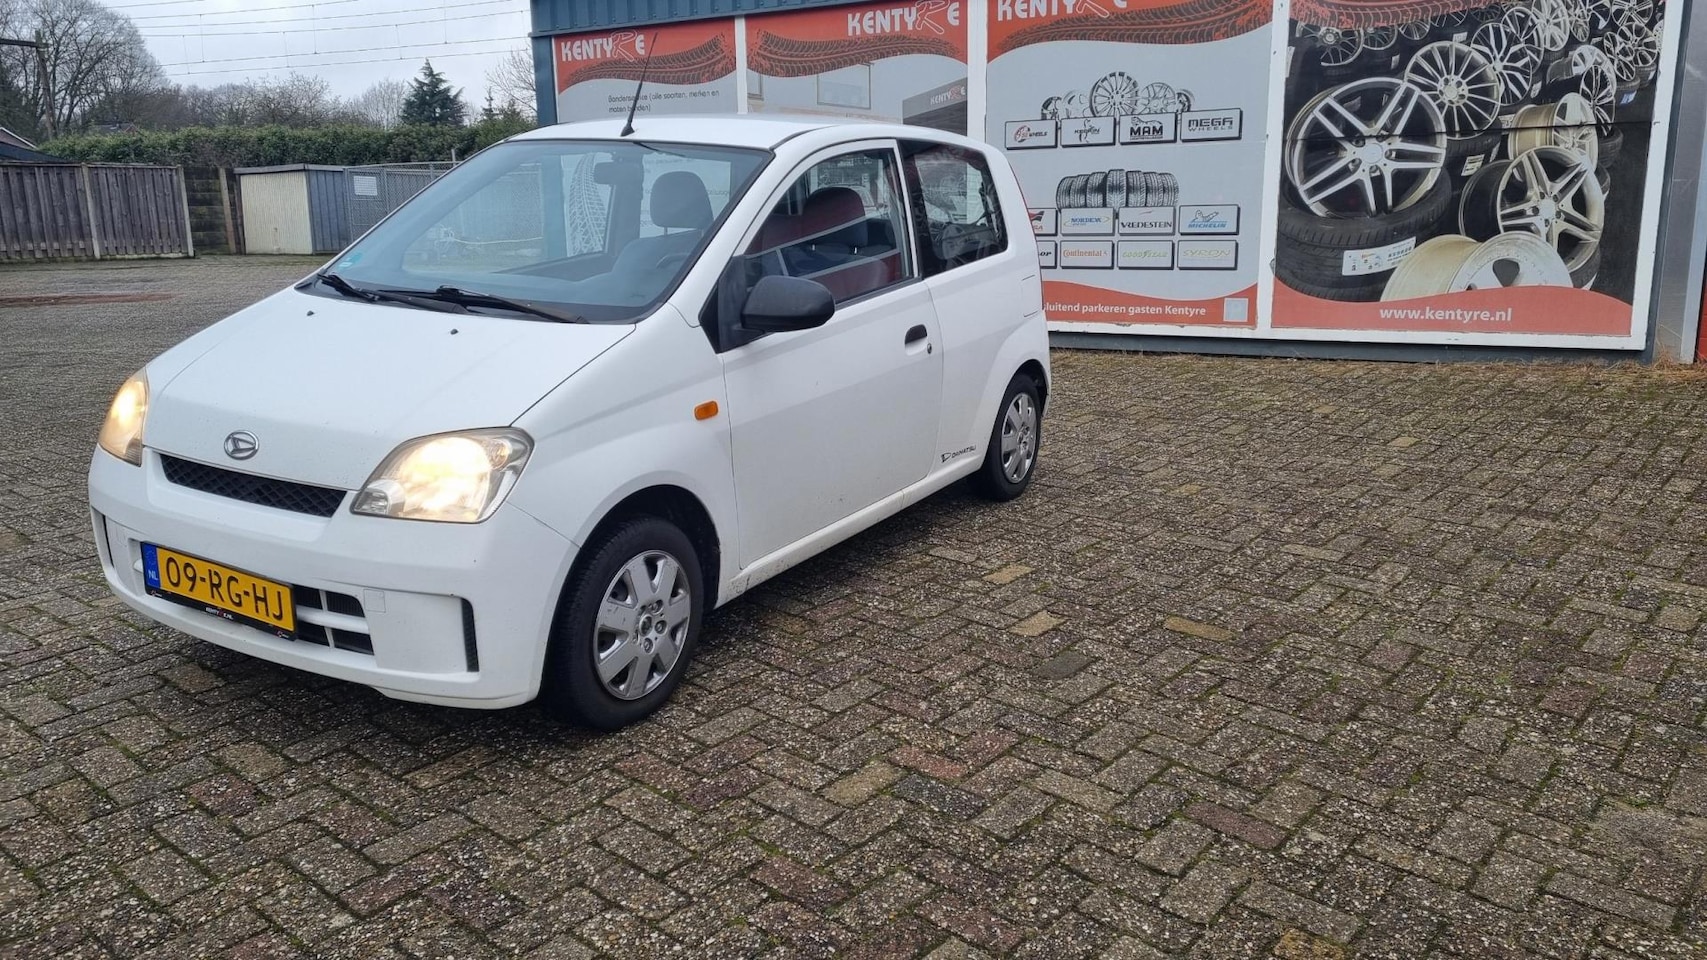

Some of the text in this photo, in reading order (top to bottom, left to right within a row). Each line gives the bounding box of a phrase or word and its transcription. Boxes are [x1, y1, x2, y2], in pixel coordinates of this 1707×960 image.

[997, 0, 1127, 20] KENTY
[847, 0, 960, 36] KENTYRE
[561, 29, 645, 62] KENTYRE
[1188, 117, 1233, 127] MEGA
[1130, 125, 1163, 136] MAM
[1063, 249, 1102, 257] Continental
[1082, 303, 1126, 313] parkeren
[1128, 305, 1163, 315] gasten
[1165, 305, 1206, 316] Kentyre
[1380, 307, 1512, 323] www.kentyre.nl
[148, 568, 158, 581] NL
[166, 556, 283, 621] 09-RG-HJ
